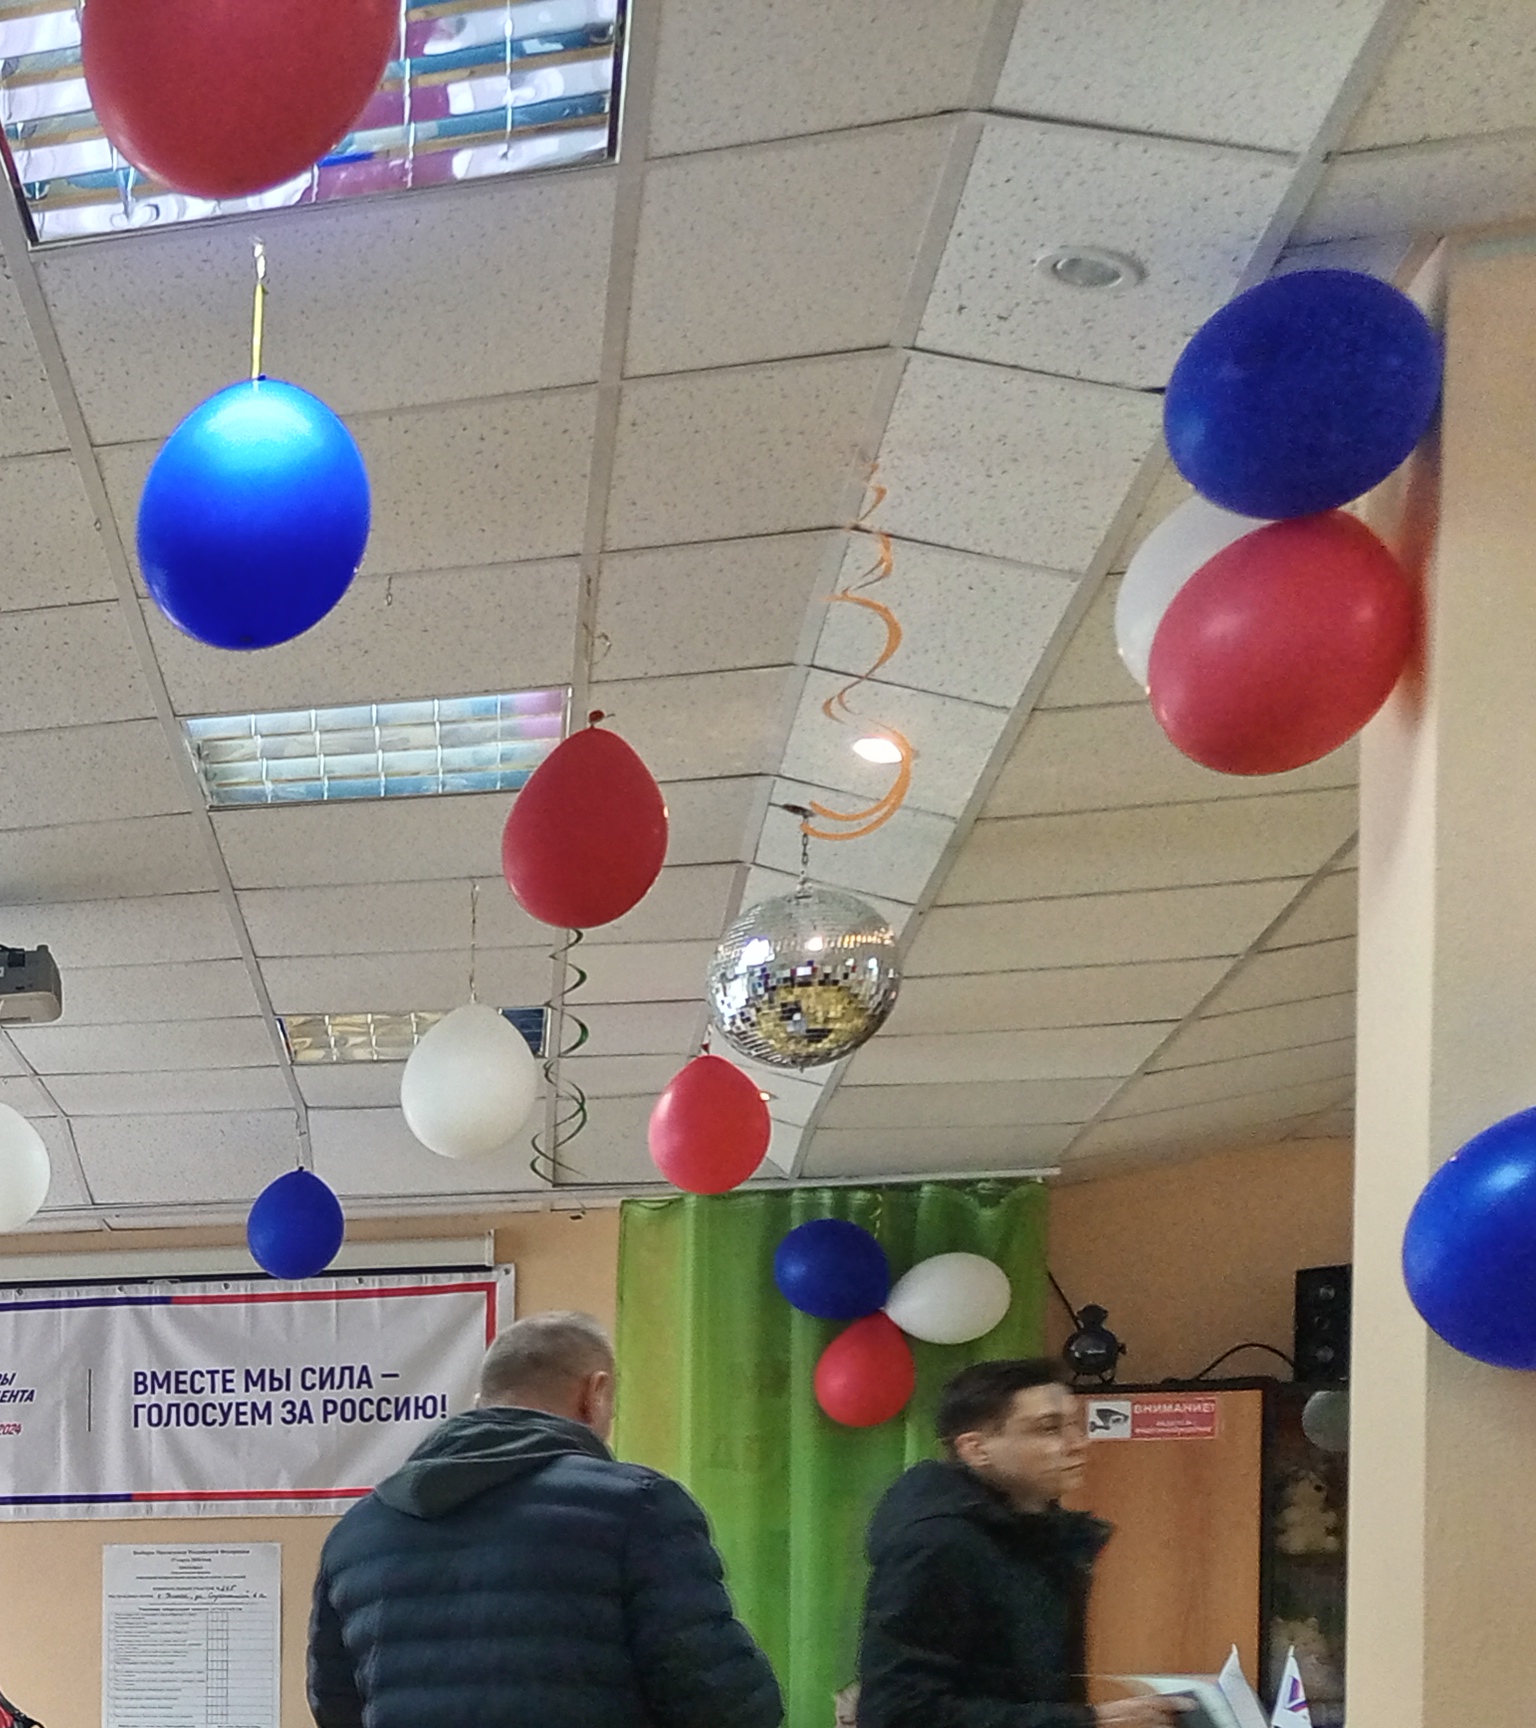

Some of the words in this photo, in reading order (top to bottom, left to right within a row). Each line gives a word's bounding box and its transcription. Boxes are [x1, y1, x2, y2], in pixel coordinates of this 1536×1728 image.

[133, 1369, 236, 1396] ВМЕСТЕ
[243, 1367, 292, 1393] МЫ
[300, 1365, 374, 1391] СИЛА
[133, 1400, 272, 1428] ГОЛОСУЕМ
[280, 1400, 314, 1425] ЗА
[322, 1394, 448, 1424] РОССИЮ!
